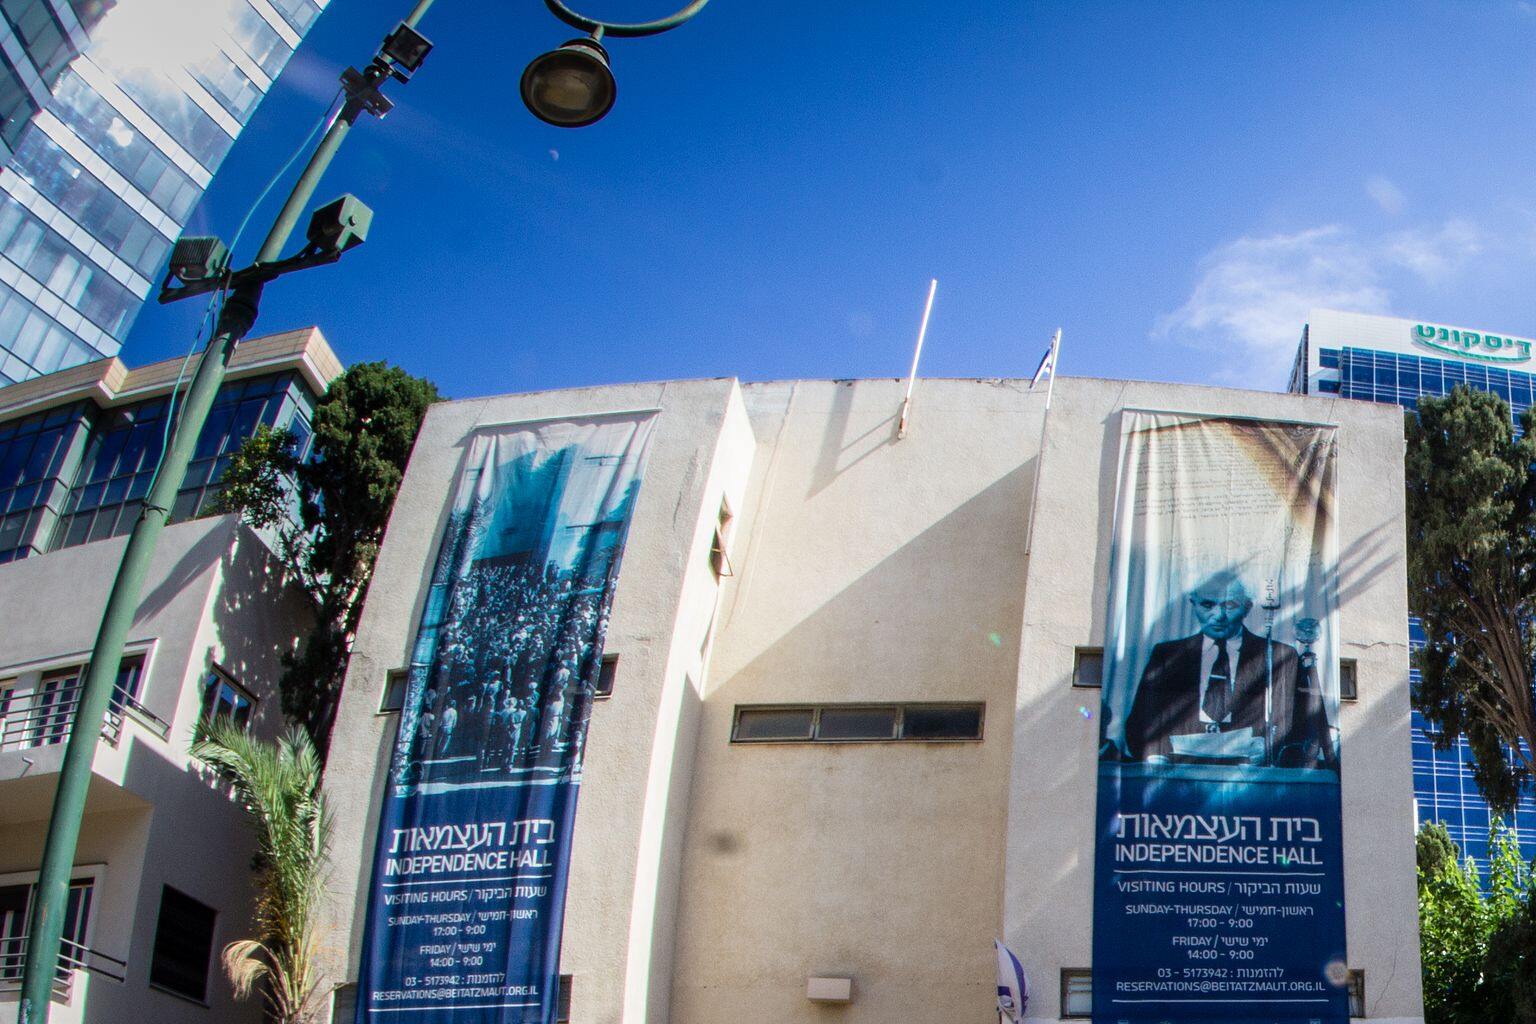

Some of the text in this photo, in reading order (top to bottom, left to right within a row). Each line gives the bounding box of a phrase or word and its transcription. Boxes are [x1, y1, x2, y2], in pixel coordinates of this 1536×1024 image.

[1417, 324, 1531, 355] דיסקונט
[1116, 813, 1323, 843] בית העצמאות
[389, 823, 506, 852] העצמאות
[1115, 844, 1323, 865] INDEPENDENCE HALL
[386, 852, 508, 876] INDEPENDENCE
[1118, 881, 1175, 893] VISITING
[1179, 881, 1225, 893] HOURS
[1235, 882, 1280, 896] הביקור
[1286, 883, 1321, 895] שעות
[384, 892, 428, 905] VISITING
[431, 890, 468, 902] HOURS
[475, 888, 512, 902] הביקור
[1125, 904, 1232, 915] SUNDAY-THURSDAY
[1241, 904, 1314, 917] ראשון-חמישי
[388, 913, 471, 926] SUNDAY-THURSDAY
[478, 910, 538, 922] ראשון-חמישי
[1188, 918, 1217, 928] 17:00
[1228, 918, 1253, 928] 9:00
[433, 926, 457, 936] 17:00
[1172, 935, 1213, 947] FRIDAY
[1221, 936, 1249, 946] שישי
[1252, 936, 1268, 946] ימי
[420, 945, 451, 955] FRIDAY
[1187, 950, 1217, 960] 14:00
[1229, 950, 1254, 960] 9:00
[430, 958, 454, 967] 14:00
[1157, 968, 1170, 977] 03
[1183, 968, 1228, 978] 5173942
[425, 975, 460, 986] 5173942
